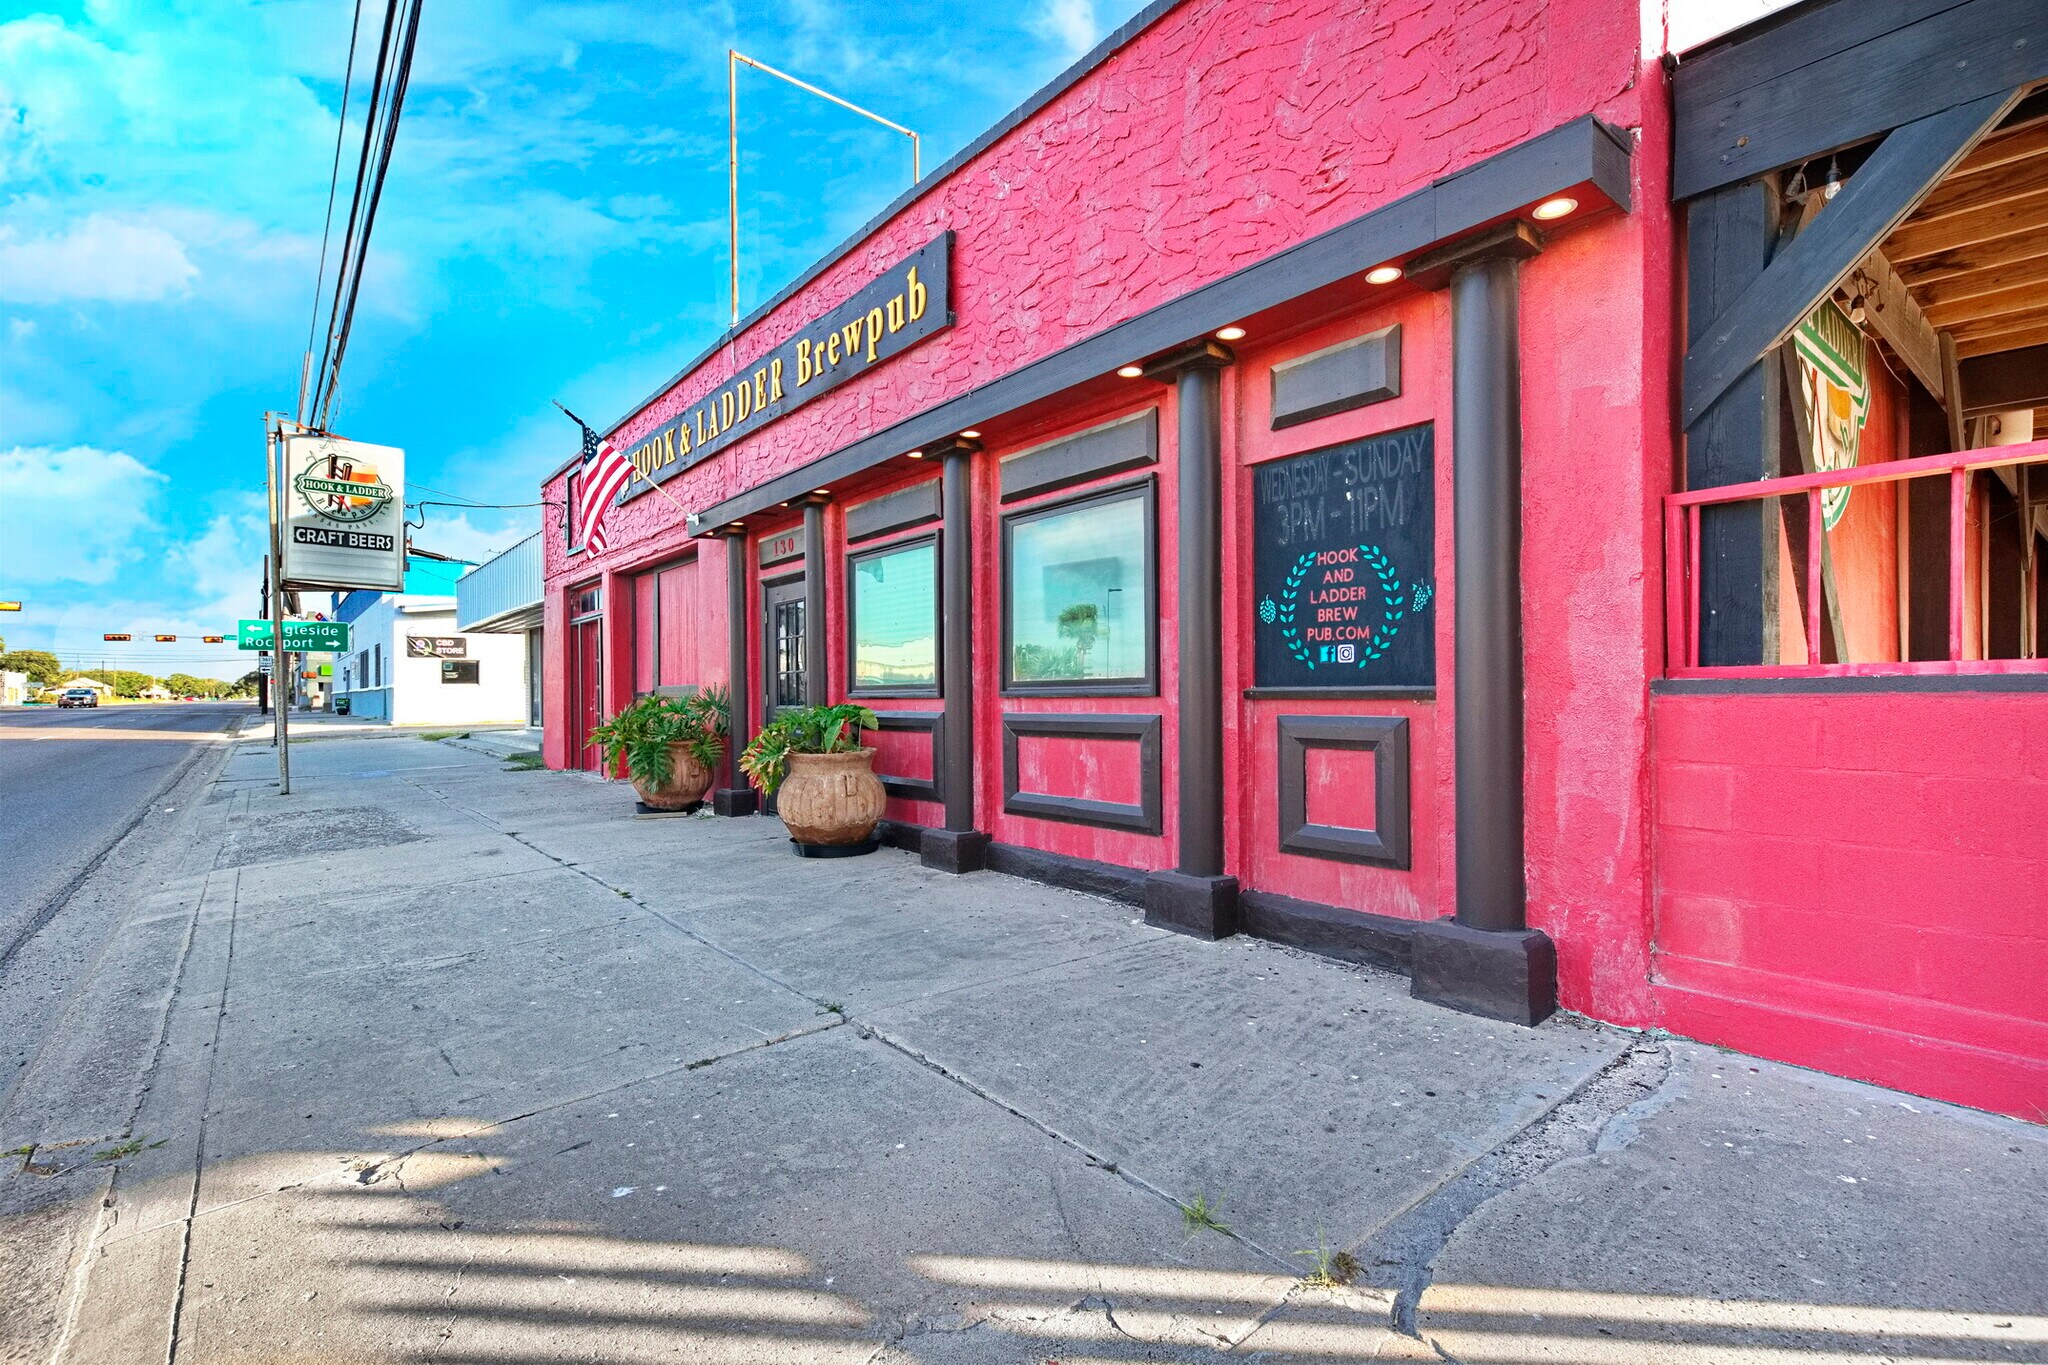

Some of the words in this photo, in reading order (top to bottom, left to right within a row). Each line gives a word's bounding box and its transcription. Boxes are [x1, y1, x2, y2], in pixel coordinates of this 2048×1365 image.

[632, 428, 676, 484] HOOK
[680, 423, 691, 456] &
[697, 358, 783, 447] LADDER
[796, 266, 927, 387] Brewpub
[1261, 454, 1330, 504] WEDNESDAY
[1345, 432, 1426, 485] SUNDAY
[305, 480, 335, 491] HOOK
[336, 484, 344, 492] &
[346, 485, 384, 497] LADDER
[317, 498, 373, 519] Brewpub
[1277, 496, 1325, 545] 3PM
[296, 529, 344, 545] CRAFT
[349, 533, 391, 549] BEERS
[773, 538, 794, 557] 130
[1317, 548, 1358, 565] HOOK
[1323, 568, 1354, 584] AND
[1310, 586, 1366, 604] LADDER
[1317, 606, 1358, 623] BREW
[270, 625, 338, 637] Igleside
[1307, 625, 1370, 642] PUB.COM
[246, 637, 313, 649] Rocport
